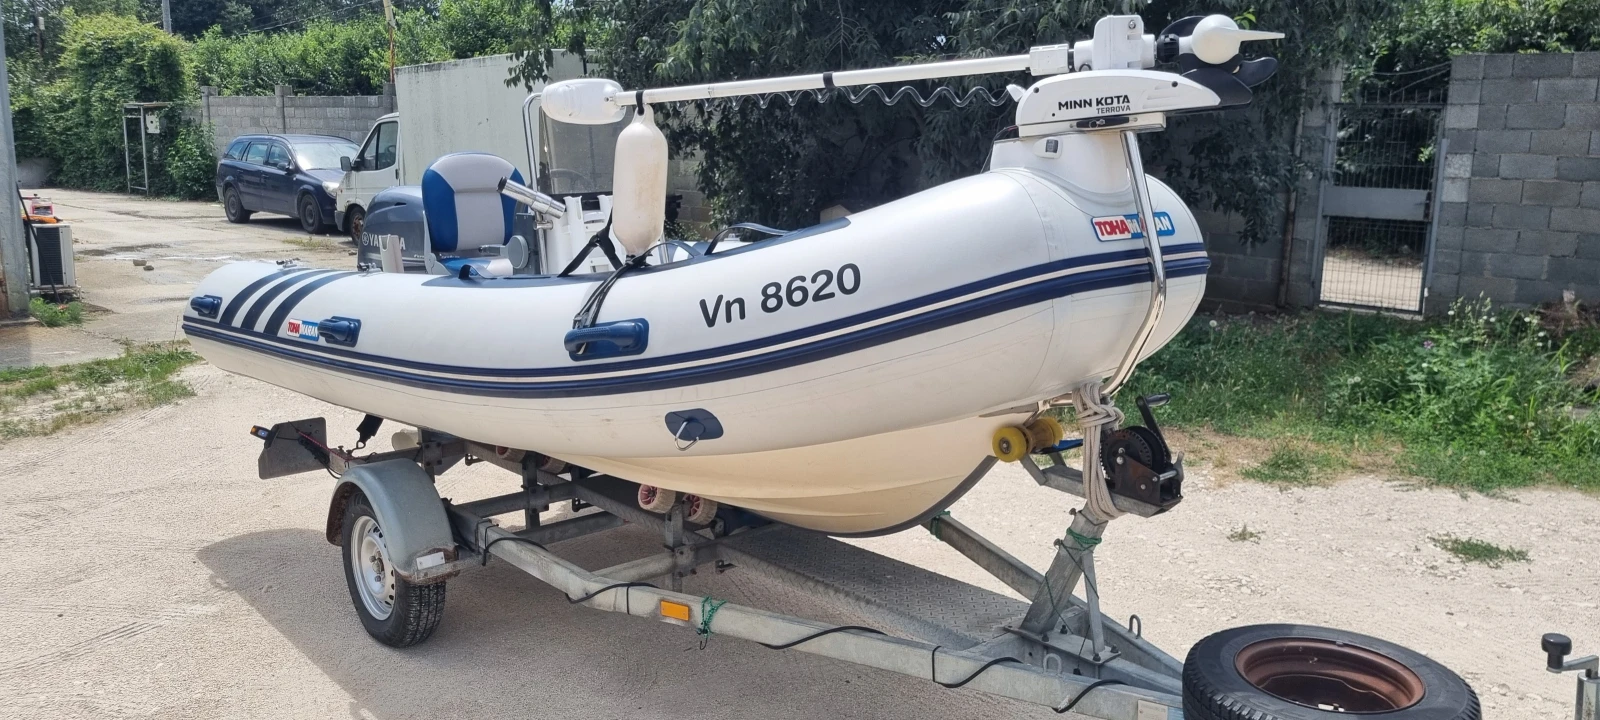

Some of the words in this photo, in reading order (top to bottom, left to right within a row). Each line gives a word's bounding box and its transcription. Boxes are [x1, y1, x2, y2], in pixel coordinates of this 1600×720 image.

[1058, 98, 1092, 111] MINN
[1096, 94, 1131, 107] KOTA
[1096, 105, 1131, 115] TERROVA
[1094, 216, 1172, 236] TOHAMAN
[699, 294, 746, 328] Vn
[760, 263, 861, 314] 8620
